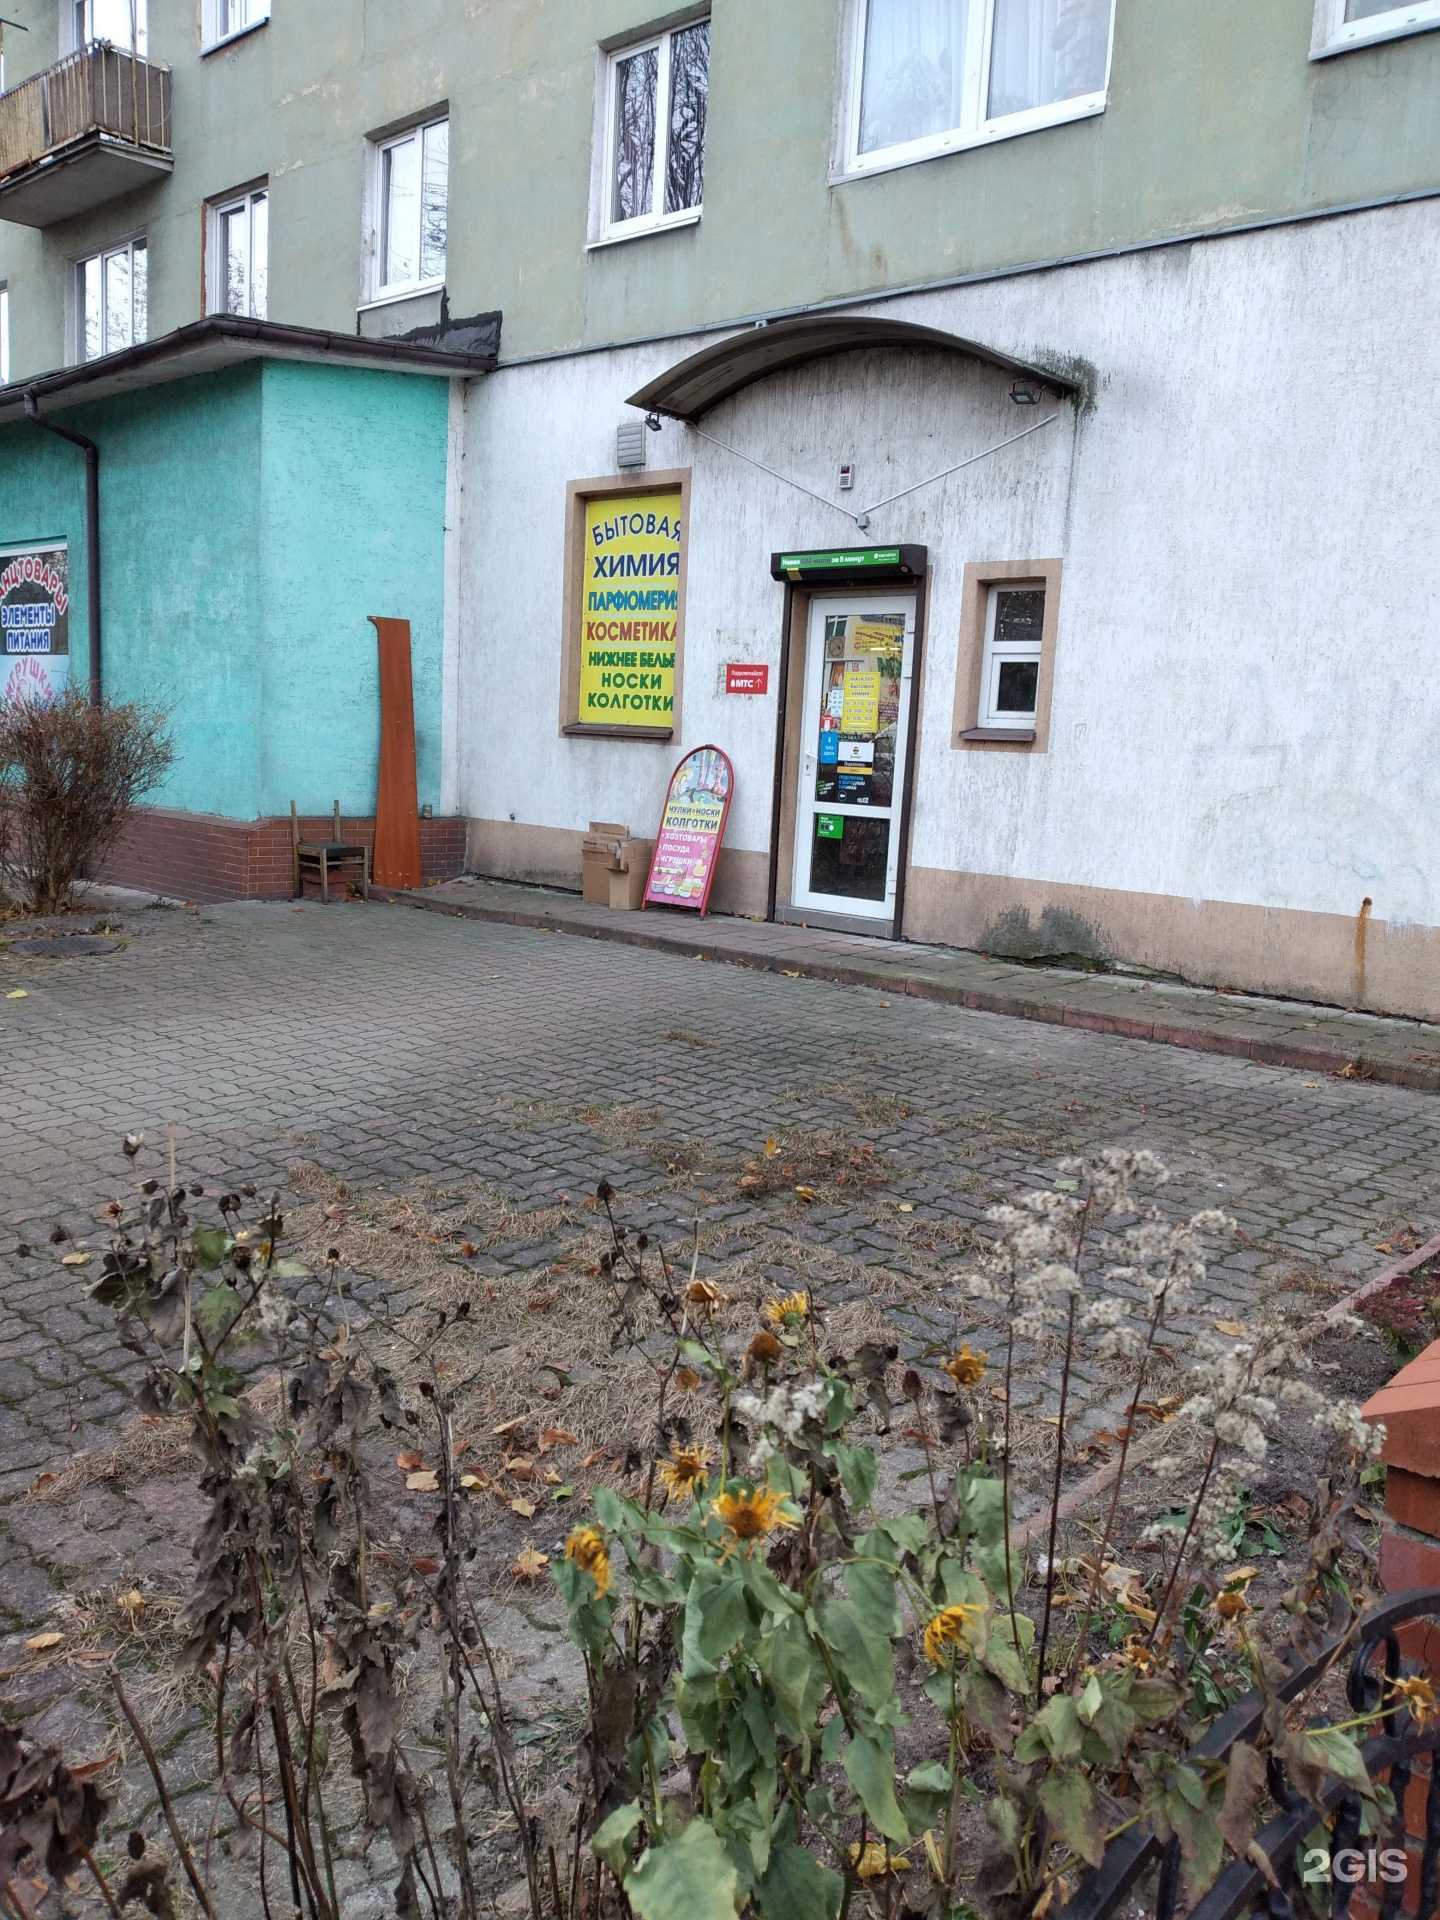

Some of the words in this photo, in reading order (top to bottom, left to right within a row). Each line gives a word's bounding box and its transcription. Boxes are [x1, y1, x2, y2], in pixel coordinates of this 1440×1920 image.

[592, 513, 681, 546] БЫТОВАЯ
[593, 552, 680, 578] ХИМИЯ
[2, 604, 56, 628] ЭЛЕМЕНТЫ
[7, 629, 50, 652] ПИТАНИЯ
[588, 651, 637, 668] НИЖНЕЕ
[601, 672, 662, 690] НОСКИ
[588, 692, 673, 711] КОЛГОТКИ
[665, 816, 718, 829] КОЛГОТКИ
